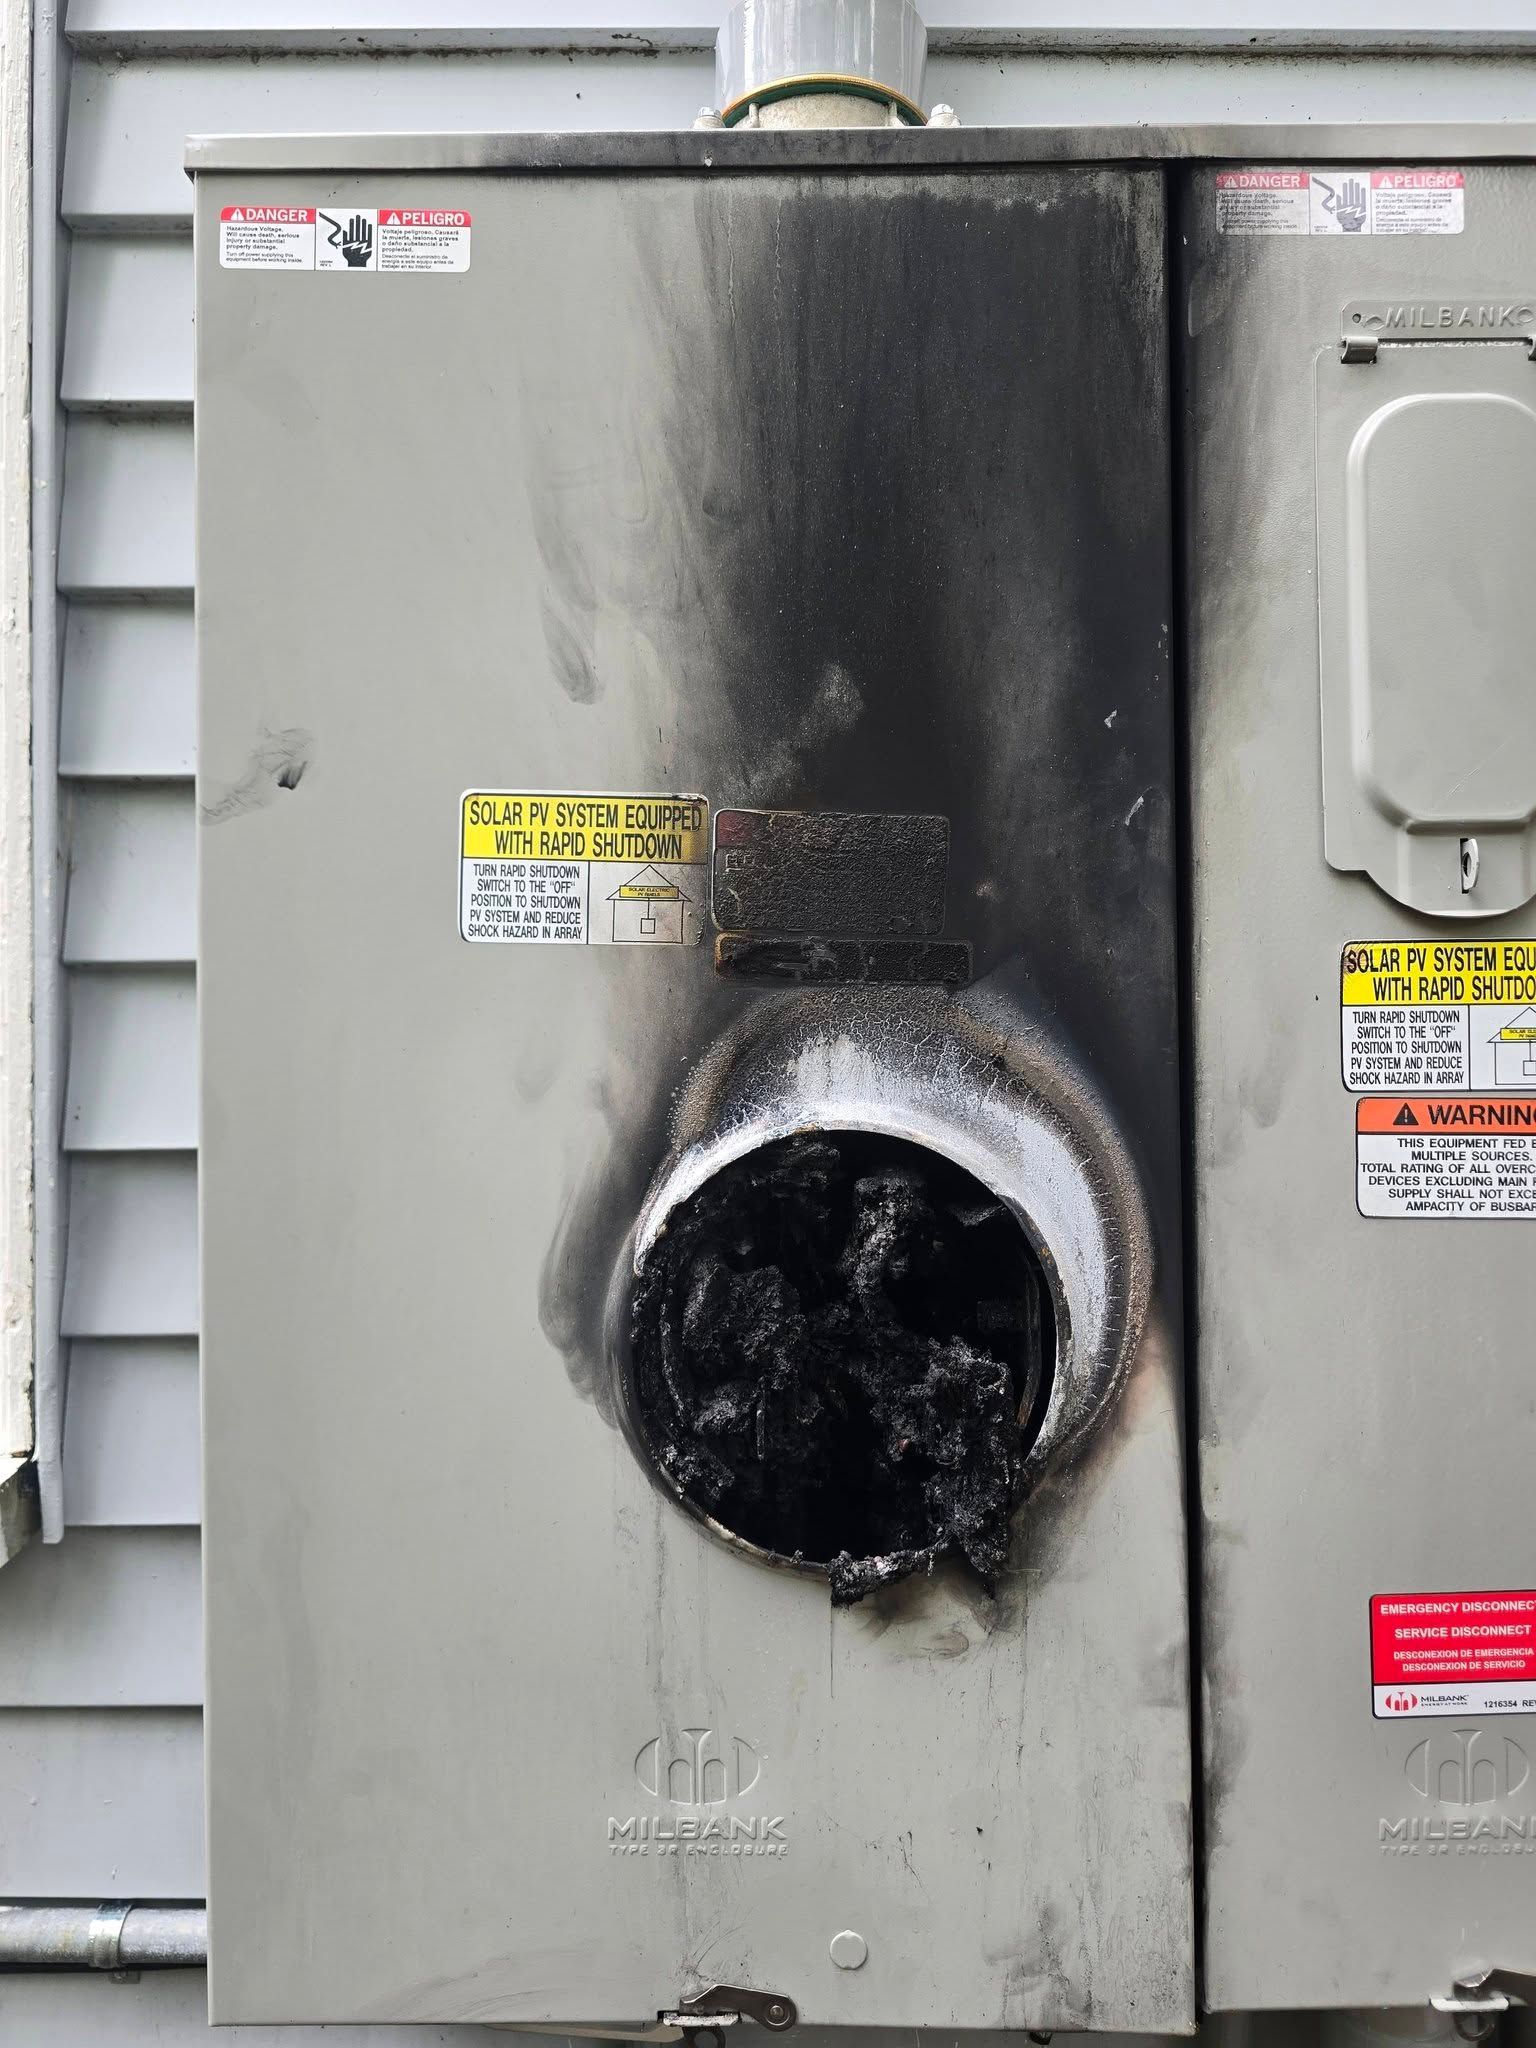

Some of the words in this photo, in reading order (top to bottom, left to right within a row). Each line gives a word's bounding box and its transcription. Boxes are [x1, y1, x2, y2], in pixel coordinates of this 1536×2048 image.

[1240, 175, 1300, 188] DANGER
[1394, 175, 1457, 188] PELIGRO
[246, 208, 308, 222] DANGER
[402, 212, 465, 226] PELIGRO
[1385, 305, 1515, 329] MILBANK
[469, 800, 523, 826] SOLAR
[529, 802, 550, 827] PV
[555, 803, 618, 829] SYSTEM
[625, 804, 701, 831] EQUIPPED
[495, 830, 533, 855] WITH
[540, 831, 585, 857] RAPID
[592, 832, 682, 860] SHUTDOWN
[473, 864, 497, 877] TURN
[500, 864, 526, 877] RAPID
[529, 865, 580, 879] SHUTDOWN
[477, 879, 511, 892] SWITCH
[514, 879, 526, 892] TO
[529, 880, 546, 893] THE
[471, 894, 512, 907] POSITION
[515, 895, 527, 908] TO
[530, 895, 581, 909] SHUTDOWN
[470, 909, 481, 922] PV
[484, 910, 520, 923] SYSTEM
[523, 911, 541, 924] AND
[545, 911, 581, 925] REDUCE
[468, 924, 499, 937] SHOCK
[502, 925, 539, 938] HAZARD
[542, 926, 551, 939] IN
[554, 926, 582, 939] ARRAY
[1346, 948, 1400, 974] SOLAR
[1407, 948, 1427, 972] PV
[1433, 946, 1497, 972] SYSTEM
[1504, 946, 1536, 972] EQU
[1373, 976, 1412, 1001] WITH
[1419, 976, 1464, 1001] RAPID
[1471, 975, 1536, 1001] SHUTDO
[1353, 1011, 1377, 1024] TURN
[1380, 1010, 1406, 1023] RAPID
[1409, 1010, 1460, 1023] SHUTDOWN
[1357, 1026, 1391, 1039] SWITCH
[1394, 1026, 1406, 1039] TO
[1409, 1026, 1426, 1039] THE
[1351, 1041, 1392, 1054] POSITION
[1396, 1041, 1408, 1054] TO
[1411, 1041, 1462, 1054] SHUTDOWN
[1351, 1057, 1364, 1070] PV
[1365, 1056, 1400, 1070] SYSTEM
[1404, 1056, 1423, 1069] AND
[1426, 1056, 1462, 1069] REDUCE
[1349, 1072, 1381, 1085] SHOCK
[1384, 1072, 1420, 1085] HAZARD
[1424, 1071, 1433, 1084] IN
[1436, 1071, 1464, 1084] ARRAY
[1428, 1104, 1536, 1125] WARNIN
[1397, 1138, 1425, 1148] THIS
[1429, 1138, 1499, 1149] EQUIPMENT
[1503, 1138, 1526, 1149] FED
[1411, 1151, 1466, 1161] MULTIPLE
[1471, 1151, 1533, 1161] SOURCES.
[1360, 1163, 1396, 1173] TOTAL
[1401, 1163, 1444, 1173] RATING
[1448, 1163, 1465, 1174] OF
[1470, 1164, 1491, 1174] ALL
[1495, 1164, 1536, 1174] OVERC
[1368, 1176, 1420, 1186] DEVICES
[1426, 1176, 1493, 1186] EXCLUDING
[1498, 1176, 1527, 1186] MAIN
[1388, 1188, 1431, 1199] SUPPLY
[1437, 1189, 1474, 1199] SHALL
[1479, 1189, 1504, 1199] NOT
[1405, 1201, 1464, 1211] AMPACITY
[1470, 1201, 1486, 1211] OF
[1380, 1602, 1459, 1615] EMERGENCY
[1461, 1600, 1536, 1612] DISCONNEC
[1394, 1627, 1448, 1639] SERVICE
[1451, 1624, 1532, 1637] DISCONNECT
[1393, 1650, 1458, 1660] DESCONEXION
[1460, 1649, 1472, 1658] DE
[1474, 1647, 1534, 1657] EMERGENCIA
[1402, 1661, 1467, 1672] DESCONEXION
[1469, 1661, 1482, 1670] DE
[1483, 1660, 1526, 1669] SERVICIO
[1484, 1700, 1518, 1708] 1216354
[608, 1816, 788, 1840] MILBANK
[1379, 1815, 1536, 1841] MILBAN
[609, 1844, 649, 1856] TYPE
[656, 1844, 678, 1856] 3R
[686, 1844, 789, 1857] ENCLOSURE
[1379, 1845, 1420, 1857] TYPE
